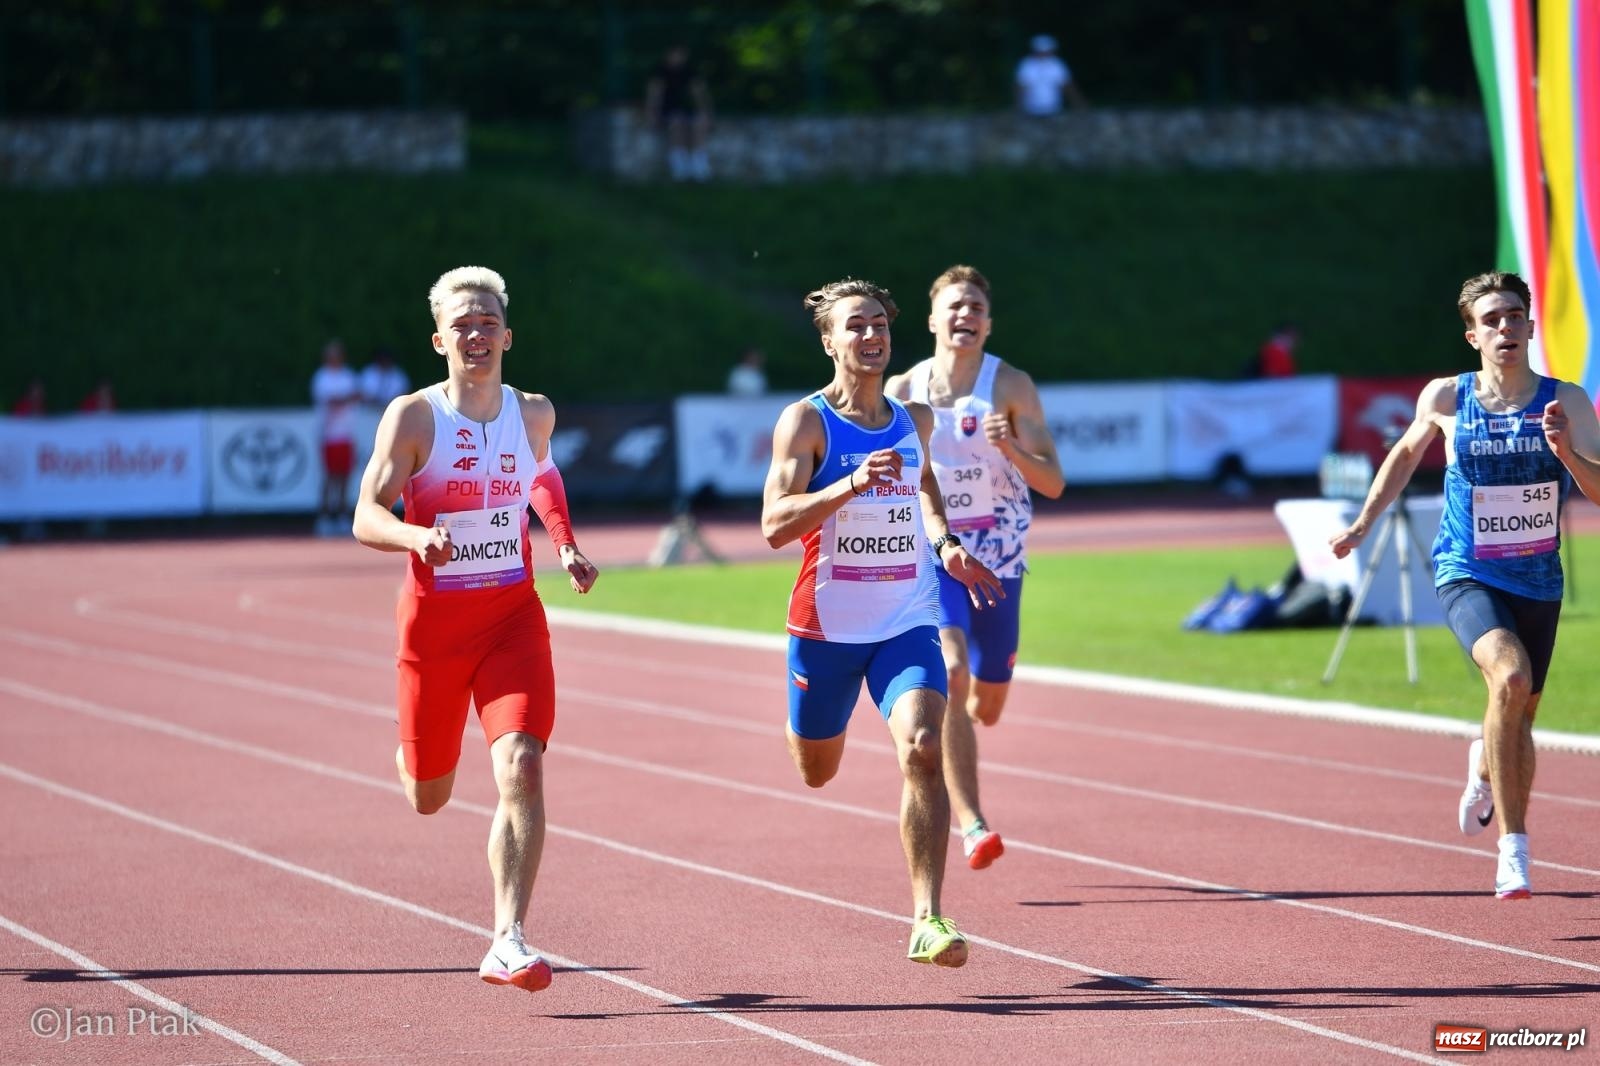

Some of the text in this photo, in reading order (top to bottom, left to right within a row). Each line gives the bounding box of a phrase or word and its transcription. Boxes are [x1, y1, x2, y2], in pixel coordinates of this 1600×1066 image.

[1470, 436, 1542, 456] CROATIA
[452, 456, 479, 471] 4F
[954, 468, 983, 483] 349
[446, 480, 522, 497] POLSKA
[1522, 487, 1551, 503] 545
[490, 511, 509, 528] 45
[887, 506, 912, 524] 145
[1478, 512, 1554, 533] DELONGA
[450, 538, 519, 562] DAMCZYK
[837, 534, 915, 555] KORECEK
